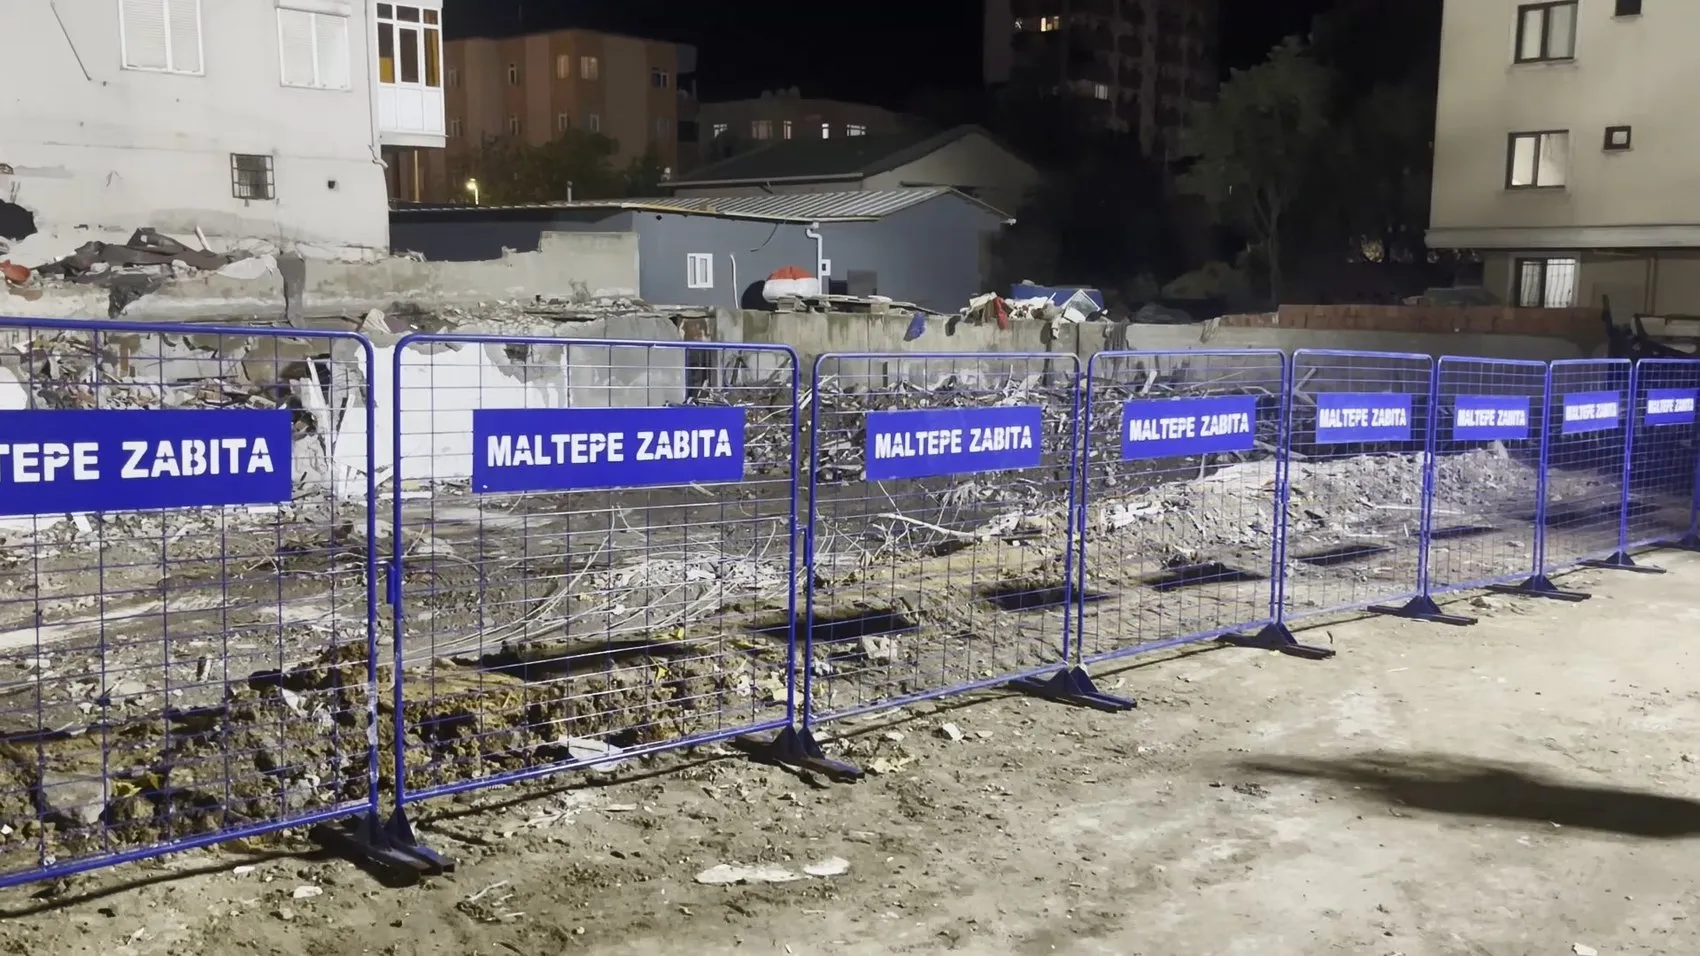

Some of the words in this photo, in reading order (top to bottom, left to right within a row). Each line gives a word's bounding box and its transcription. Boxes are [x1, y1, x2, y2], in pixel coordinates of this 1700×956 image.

[1129, 416, 1197, 442] MALTEPE
[1200, 413, 1250, 437] ZABITA
[1319, 408, 1369, 428] MALTEPE
[1371, 408, 1408, 427] ZABITA
[1457, 409, 1496, 427] MALTEPE
[1497, 409, 1526, 427] ZABITA
[120, 437, 274, 479] ZABITA
[487, 432, 624, 467] MALTEPE
[635, 428, 733, 461] ZABITA
[874, 428, 963, 460] MALTEPE
[968, 425, 1033, 453] ZABITA
